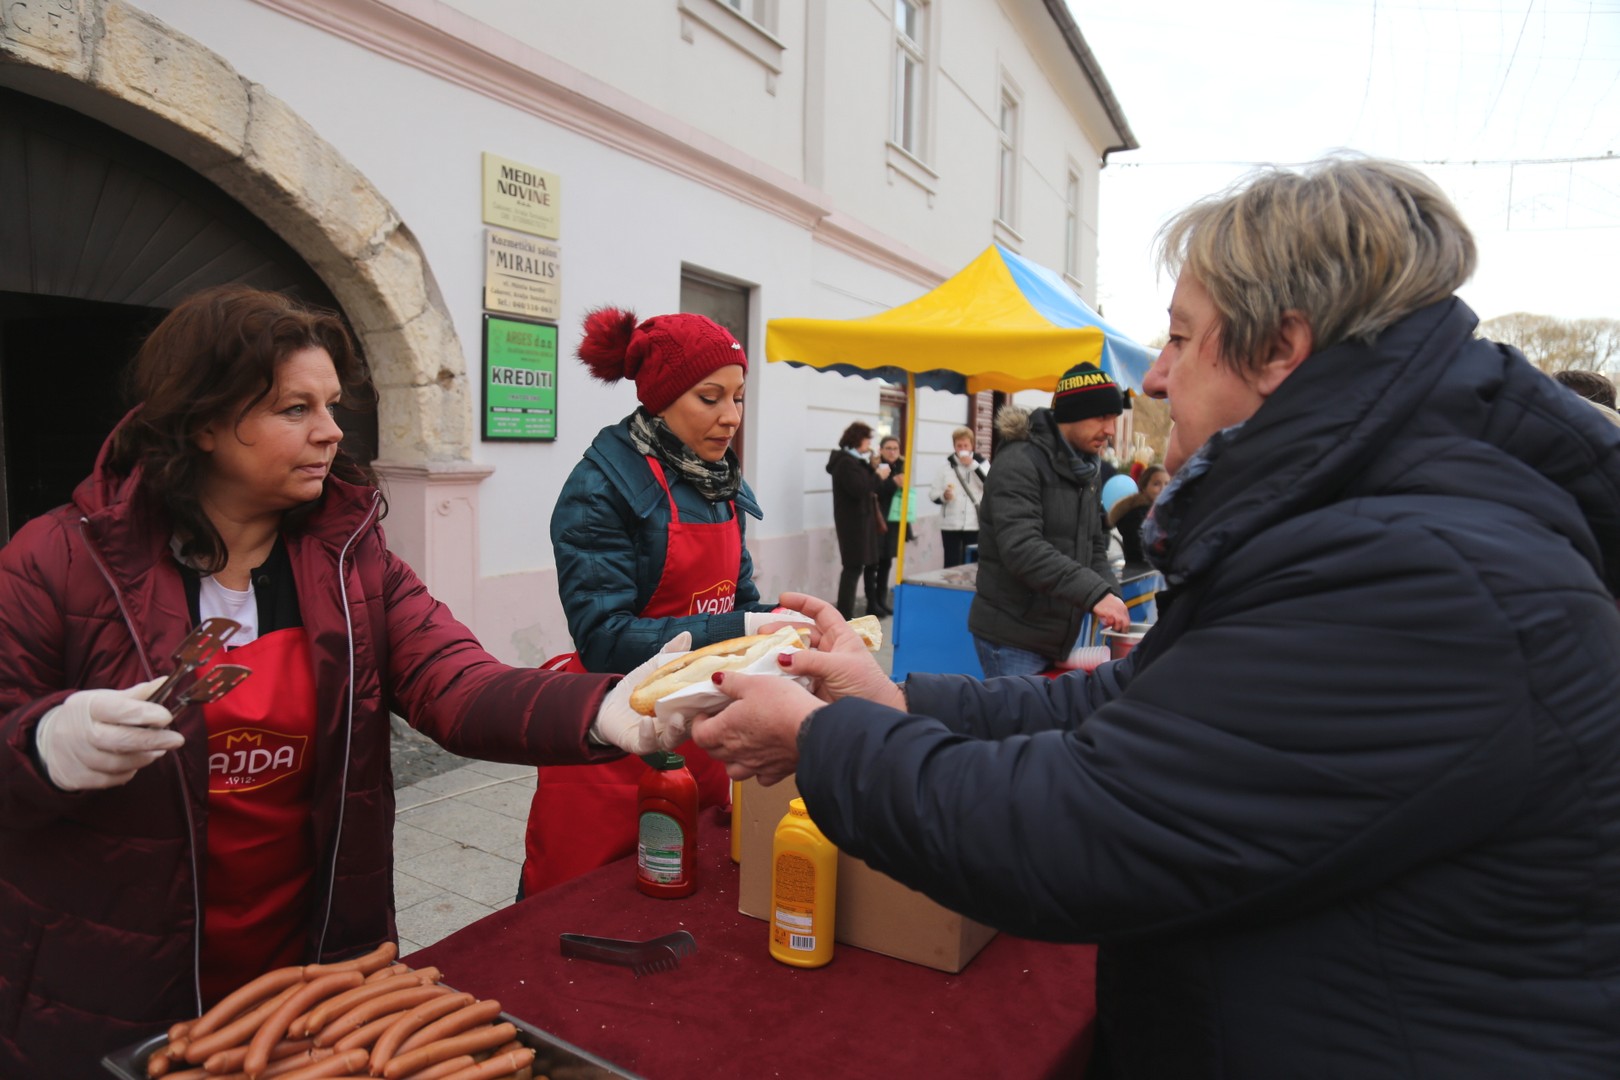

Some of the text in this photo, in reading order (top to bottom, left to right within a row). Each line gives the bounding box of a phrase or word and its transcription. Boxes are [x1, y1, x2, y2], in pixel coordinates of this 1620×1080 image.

[501, 164, 546, 191] MEDIA
[497, 179, 550, 207] NOVINE
[492, 368, 552, 388] KREDITI
[1057, 373, 1105, 393] STERDAM
[696, 593, 735, 615] VAJDA
